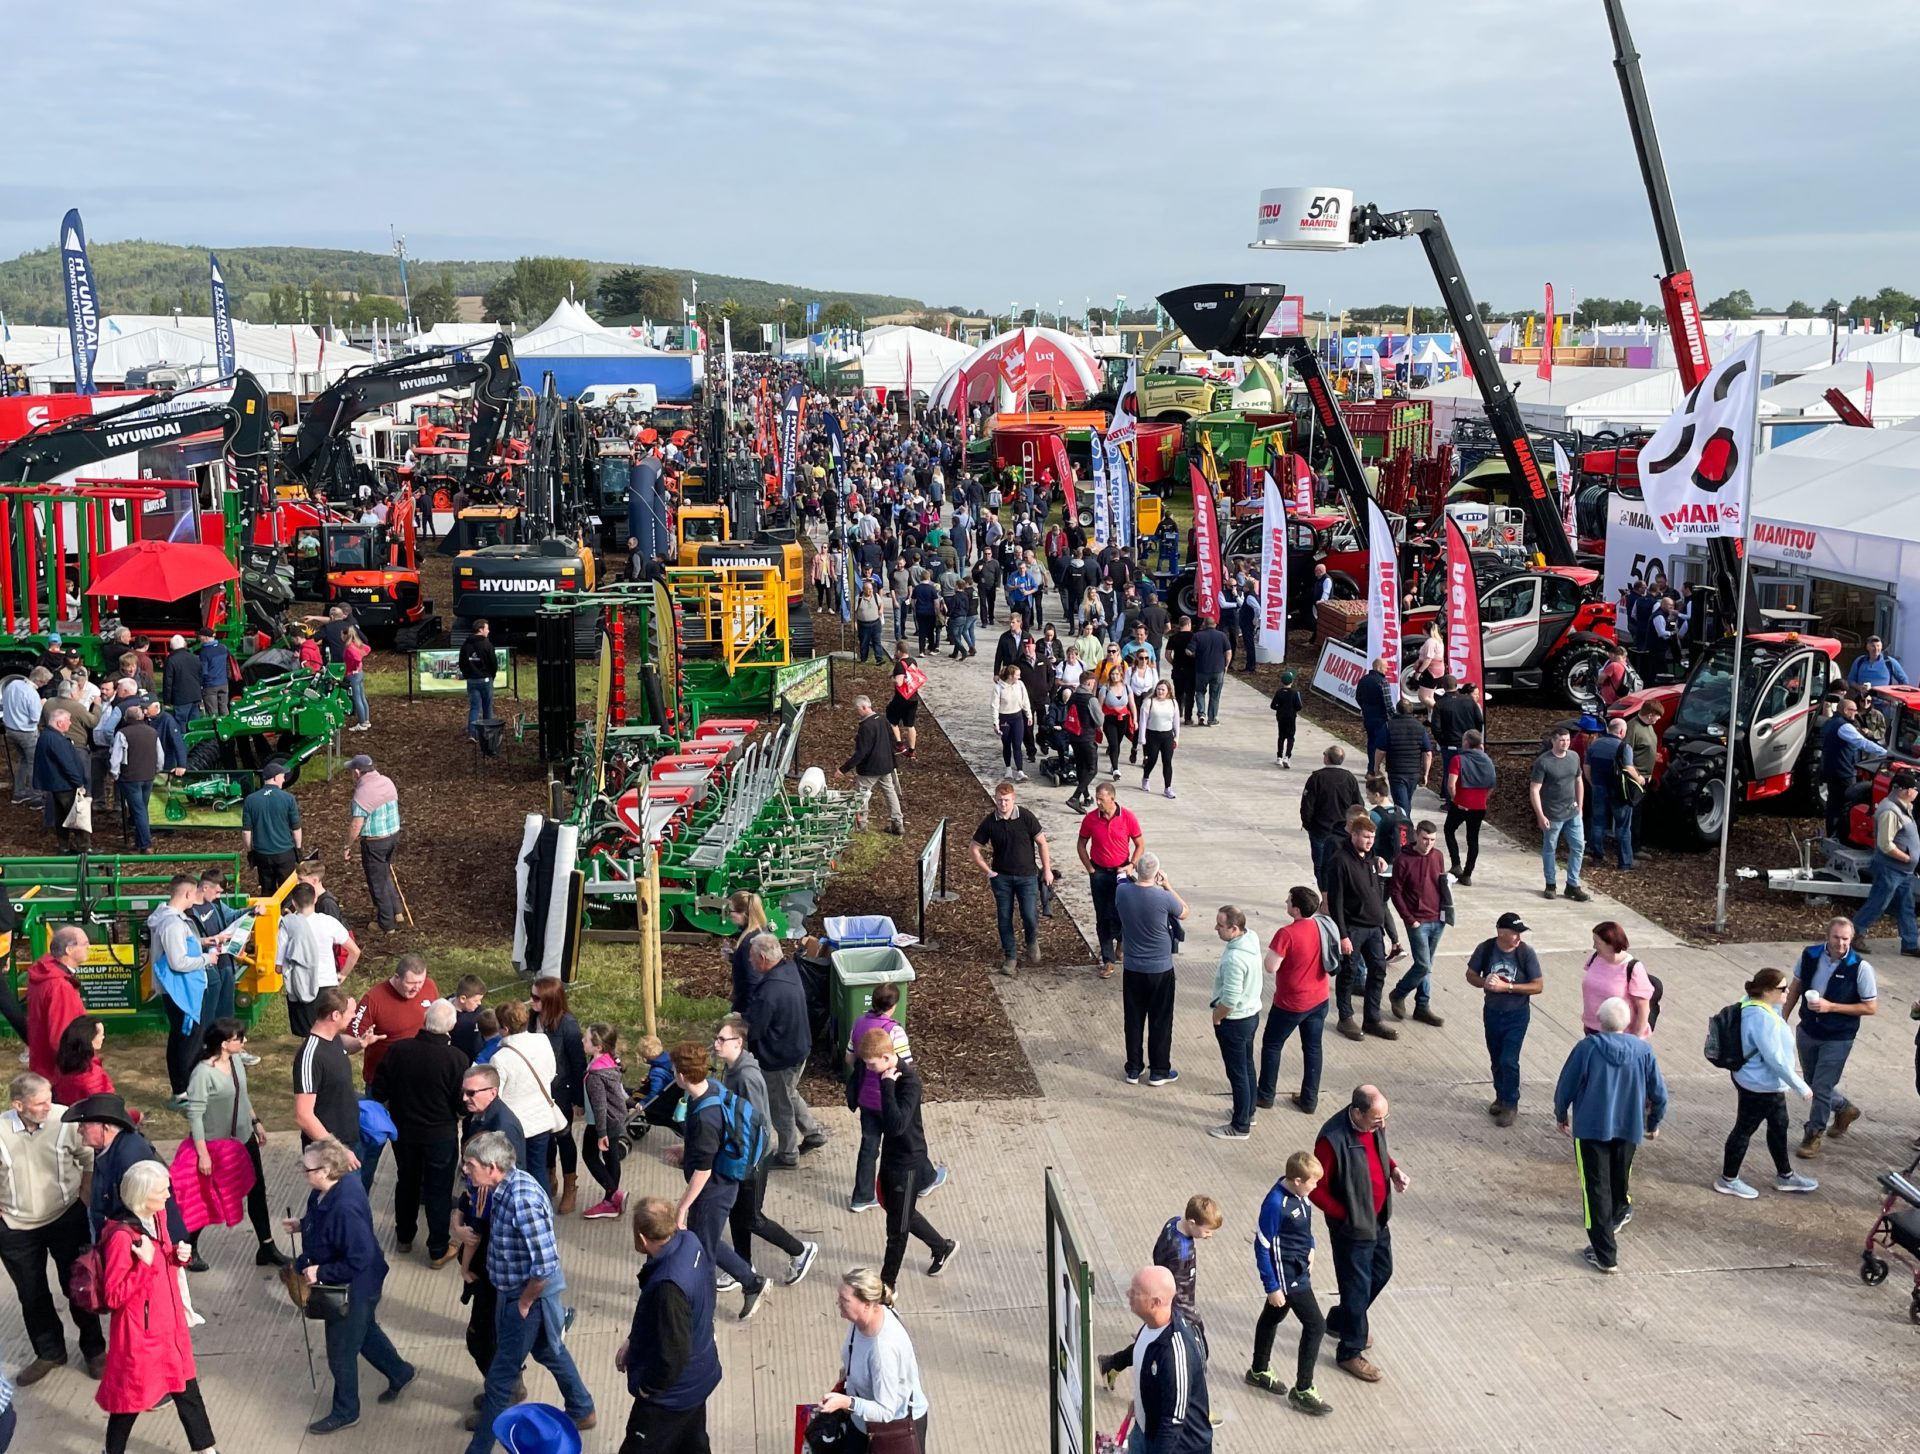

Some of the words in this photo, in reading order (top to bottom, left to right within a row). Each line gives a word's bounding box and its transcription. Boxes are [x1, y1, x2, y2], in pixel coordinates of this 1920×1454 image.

[1308, 197, 1340, 219] 50
[1300, 219, 1338, 228] MANITOU
[1450, 276, 1458, 284] A
[75, 257, 98, 351] HYUNDAI
[68, 257, 83, 332] CONSTRUCTION
[76, 335, 89, 387] EQUIPMEN
[217, 286, 233, 358] HYUNDAI
[1465, 313, 1473, 321] B
[1680, 301, 1705, 365] MANITOU
[1479, 348, 1487, 356] C
[399, 373, 448, 390] HYUNDAI
[1493, 384, 1501, 393] D
[1308, 377, 1336, 427] MANITOU
[106, 422, 182, 448] HYUNDAI
[786, 415, 797, 475] HYUNDAI
[1512, 437, 1547, 500] MANITOU
[1753, 523, 1817, 551] MANITOU
[711, 557, 772, 566] HYUNDAI
[1783, 548, 1812, 561] GROUP
[479, 579, 556, 592] HYUNDAI
[1338, 683, 1357, 699] GROU
[241, 715, 273, 723] SAMCO
[613, 893, 638, 901] SAM
